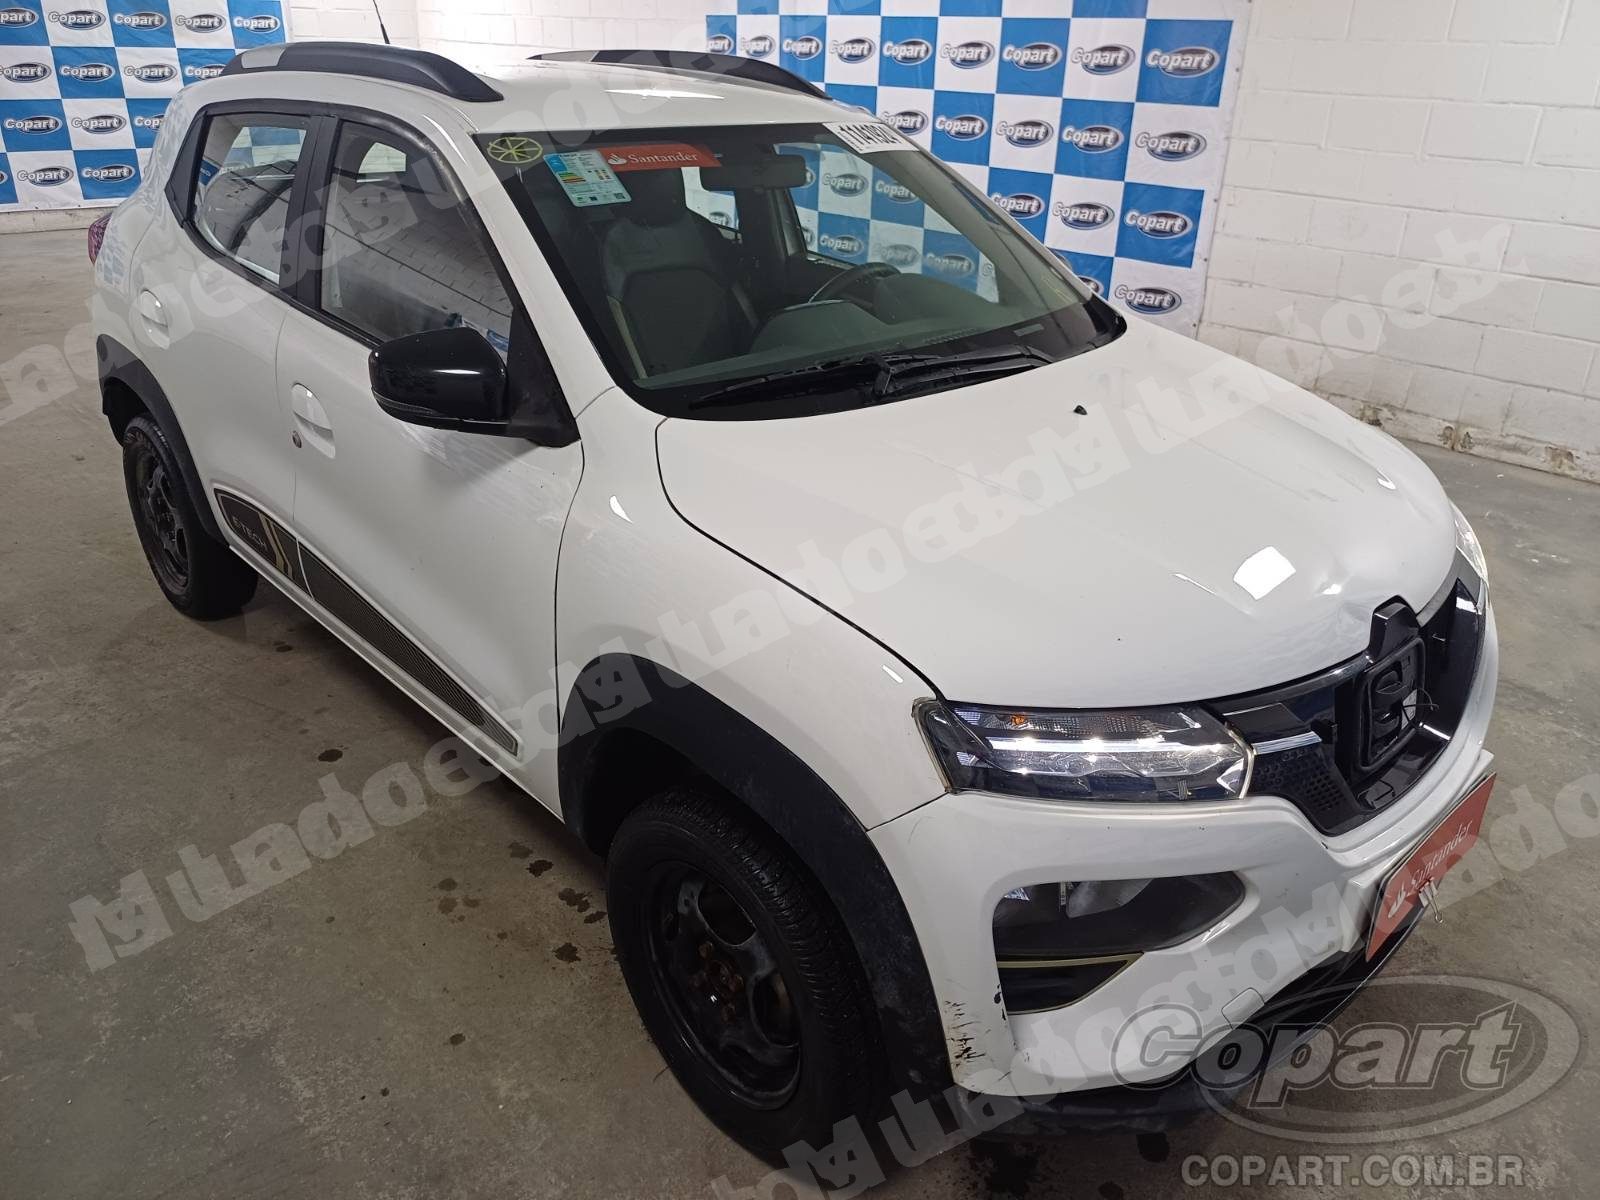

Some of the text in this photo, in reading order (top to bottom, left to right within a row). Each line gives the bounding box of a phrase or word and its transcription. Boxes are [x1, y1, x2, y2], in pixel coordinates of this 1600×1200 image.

[0, 9, 31, 24] part
[49, 11, 97, 25] Copart
[113, 13, 164, 28] Copart
[176, 15, 219, 28] Copart
[234, 16, 275, 30] Copart
[783, 38, 818, 56] Copart
[830, 40, 870, 58] Copart
[882, 41, 927, 59] Copart
[940, 43, 988, 62] Copart
[1002, 43, 1055, 65] Copart
[1071, 47, 1126, 69] Copart
[1146, 49, 1211, 72] Copart
[60, 65, 109, 79] Copart
[124, 66, 170, 79] Copart
[185, 66, 223, 78] Copar
[5, 118, 55, 133] Copart
[71, 117, 118, 132] Copart
[935, 115, 982, 135] Copart
[996, 123, 1047, 142] Copart
[1062, 126, 1115, 147] Copart
[1135, 132, 1197, 153] Copart
[627, 152, 698, 164] Santander
[18, 169, 66, 184] Copart
[82, 167, 130, 181] Copart
[822, 172, 862, 191] Copart
[991, 191, 1039, 213] Copart
[1053, 202, 1105, 223] Copart
[1124, 211, 1184, 234] Copart
[820, 234, 858, 253] Copart
[1115, 284, 1172, 308] Copart
[1412, 820, 1473, 891] Santander
